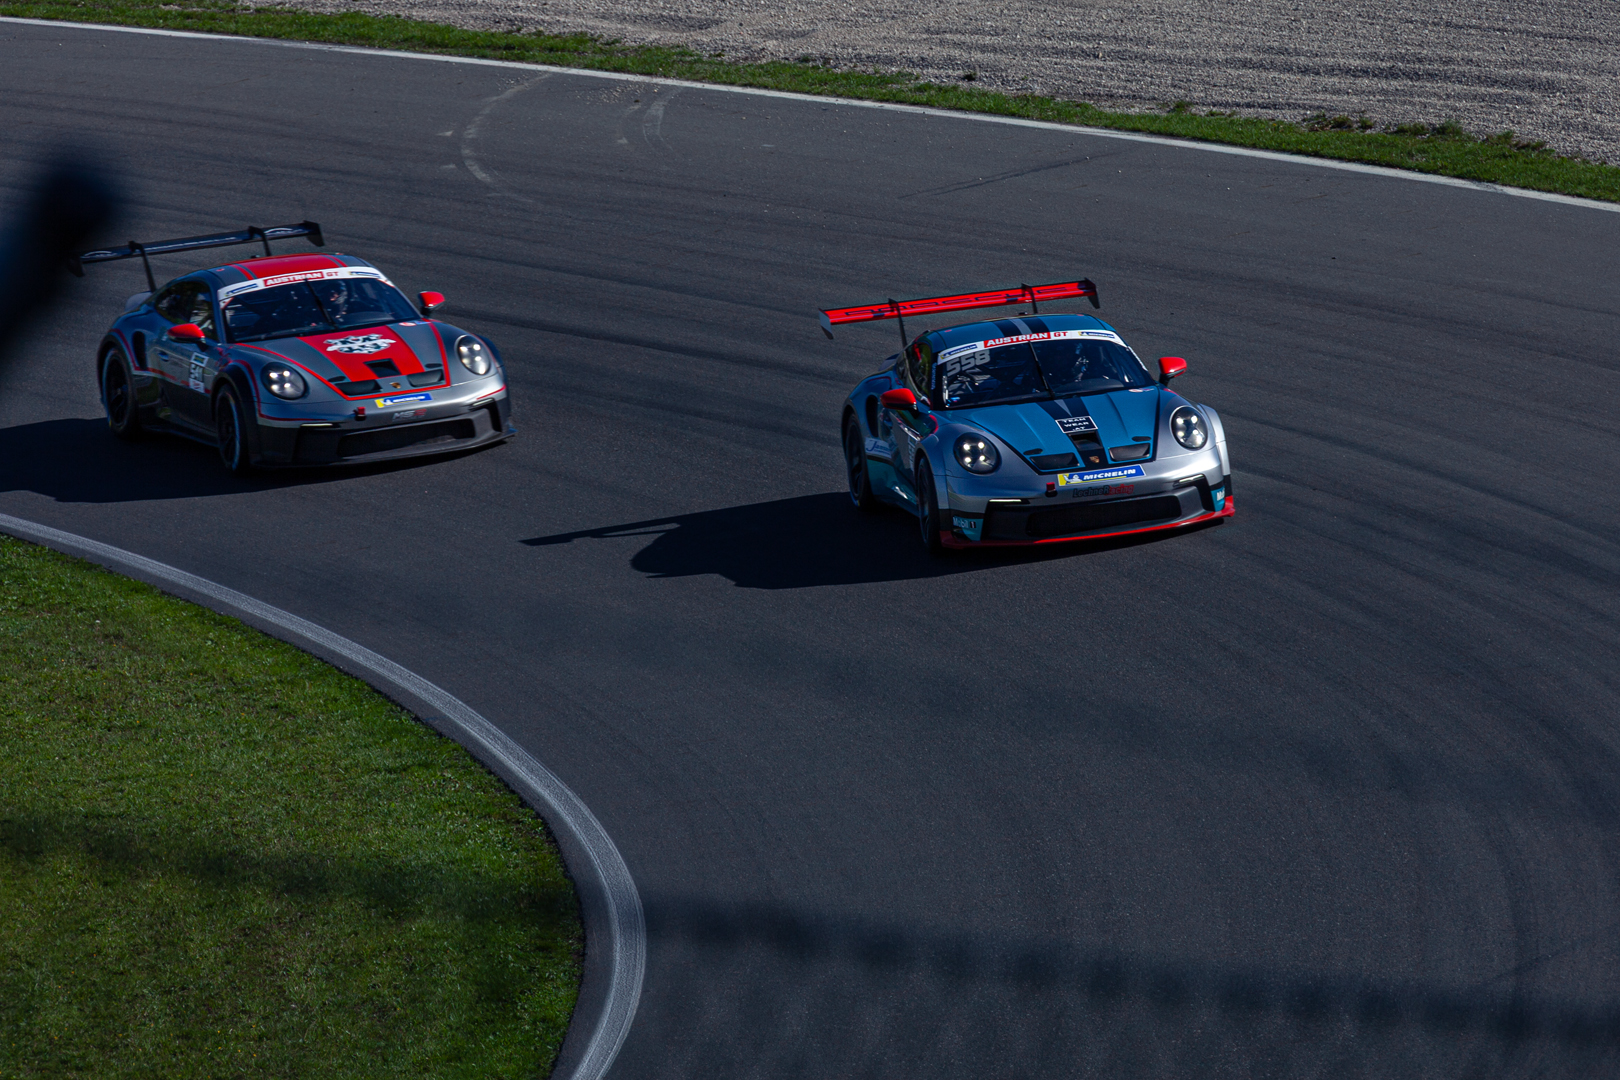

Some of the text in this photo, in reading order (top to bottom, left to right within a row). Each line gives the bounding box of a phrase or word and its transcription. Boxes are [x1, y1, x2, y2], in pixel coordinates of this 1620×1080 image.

[265, 272, 322, 286] AUSTRIAN
[986, 332, 1049, 347] AUSTRIAN
[946, 350, 991, 377] 558
[1083, 468, 1137, 481] MICHELIN
